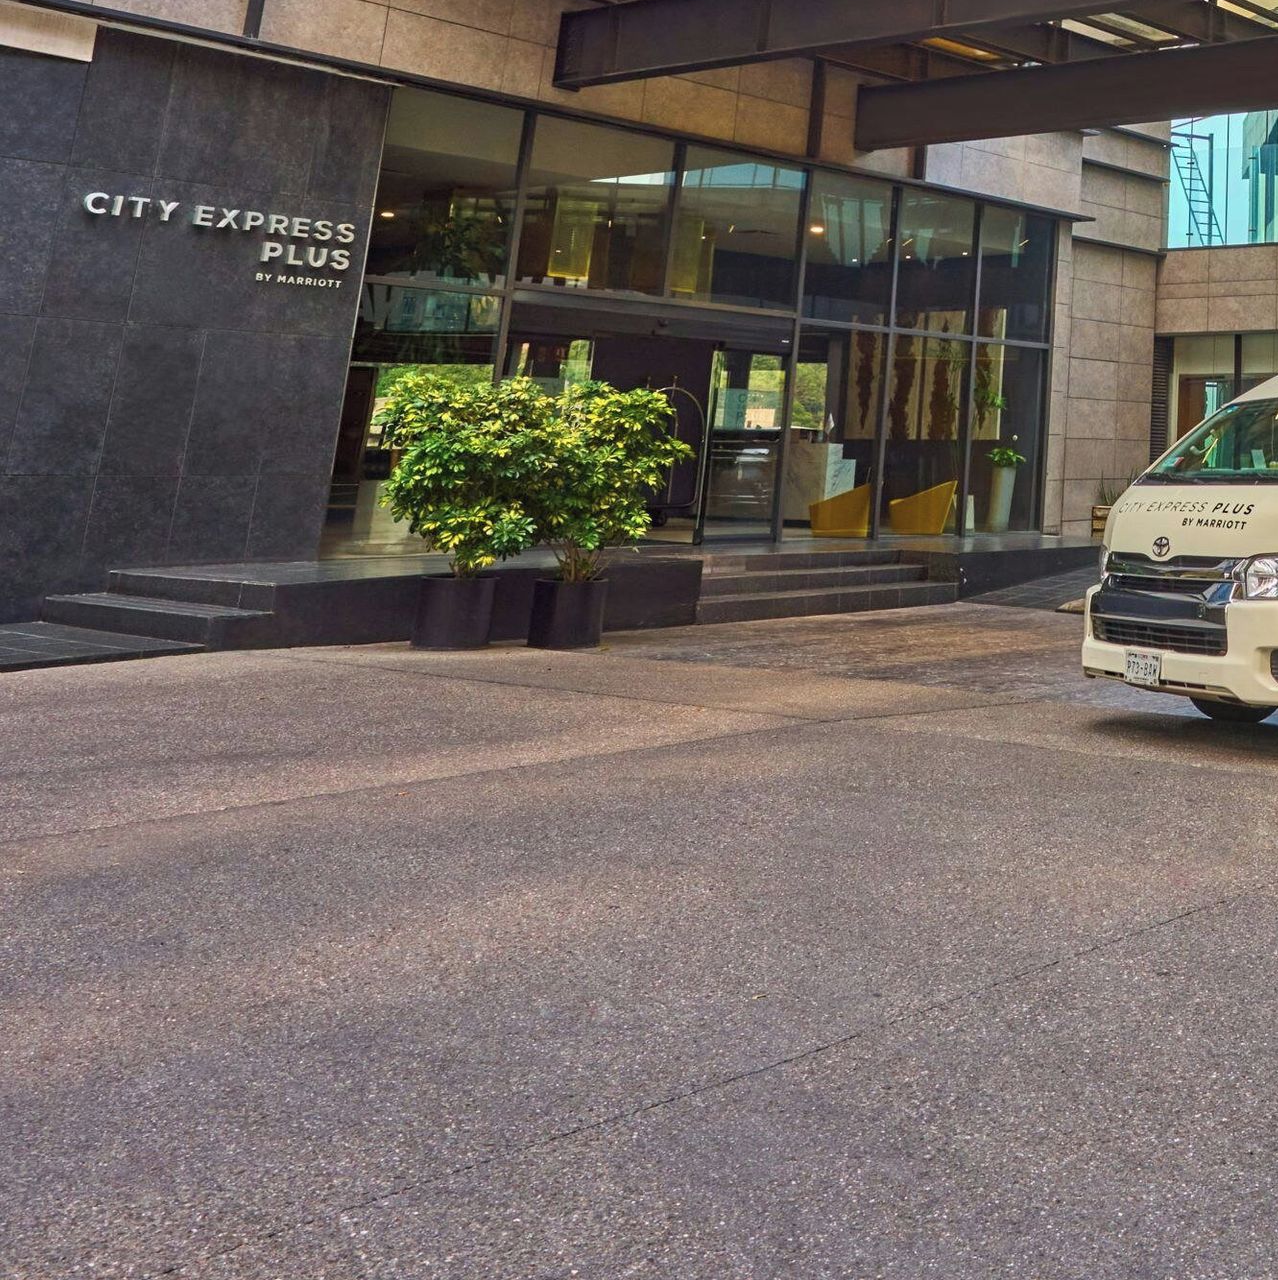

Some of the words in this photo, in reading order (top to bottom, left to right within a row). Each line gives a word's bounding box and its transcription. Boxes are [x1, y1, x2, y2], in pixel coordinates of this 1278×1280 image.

[83, 192, 180, 221] CITY
[192, 205, 355, 243] EXPRESS
[259, 241, 351, 270] PLUS
[255, 272, 272, 282] BY
[276, 274, 342, 288] MARRIOTT
[1118, 502, 1144, 514] CITY
[1146, 501, 1209, 513] EXPRESS
[1211, 502, 1256, 515] PLUS
[1181, 517, 1194, 527] BY
[1195, 518, 1247, 530] MARRIOTT
